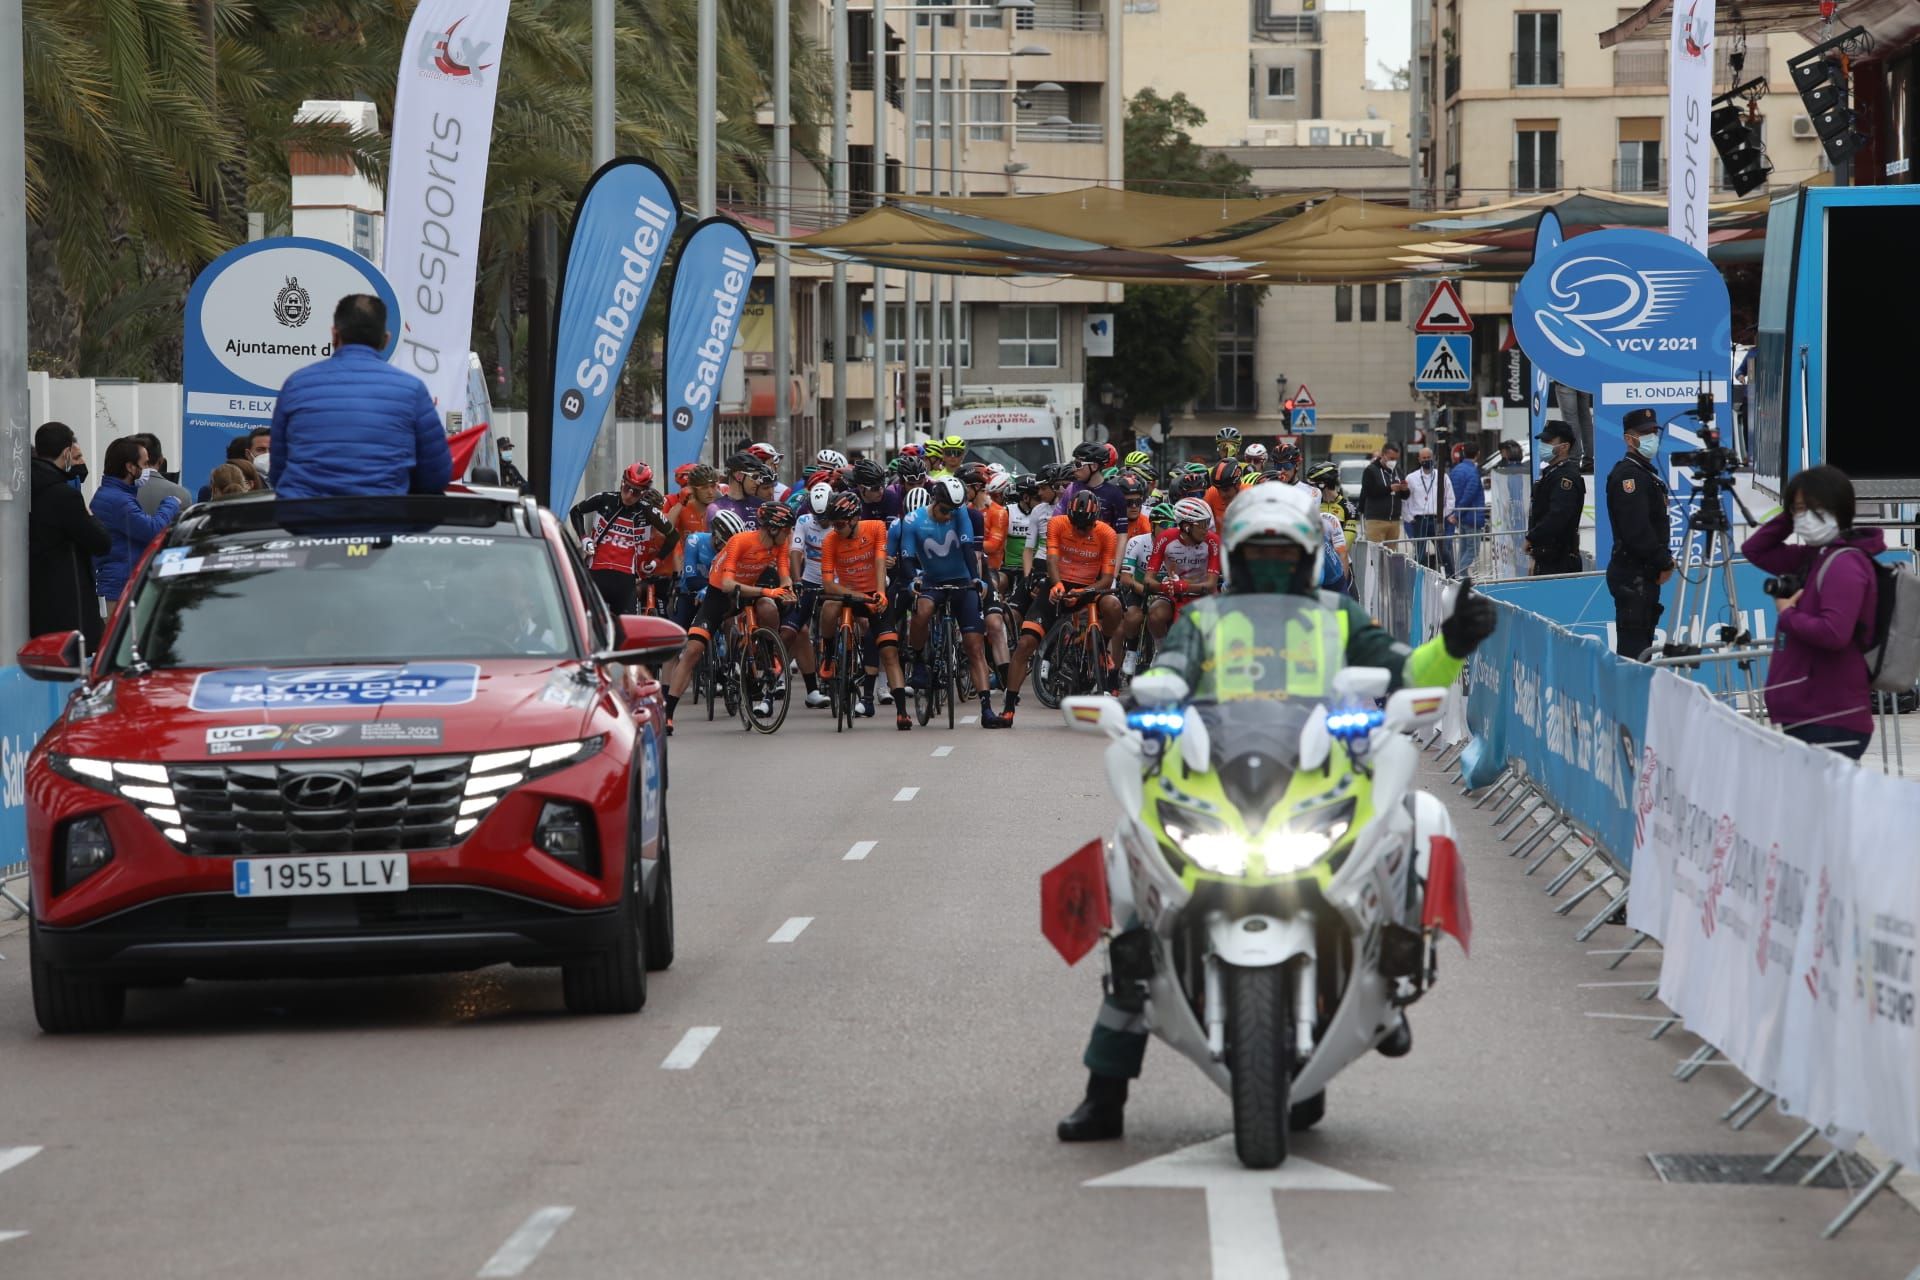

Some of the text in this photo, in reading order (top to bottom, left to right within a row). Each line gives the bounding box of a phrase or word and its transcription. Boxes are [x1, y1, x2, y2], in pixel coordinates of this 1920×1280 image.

[576, 195, 671, 397] Sabadell
[684, 247, 751, 412] Sabadell
[225, 339, 331, 357] Ajuntament d
[1616, 337, 1697, 352] VCV 2021
[1626, 387, 1642, 399] E1.
[228, 399, 272, 412] E1. ELX
[299, 534, 495, 547] HYUNDAI Koryo Car
[346, 544, 368, 556] M
[234, 679, 437, 692] HYUNDAI
[360, 688, 437, 699] Car
[213, 728, 252, 740] UCI
[264, 860, 396, 890] 1955 LLV
